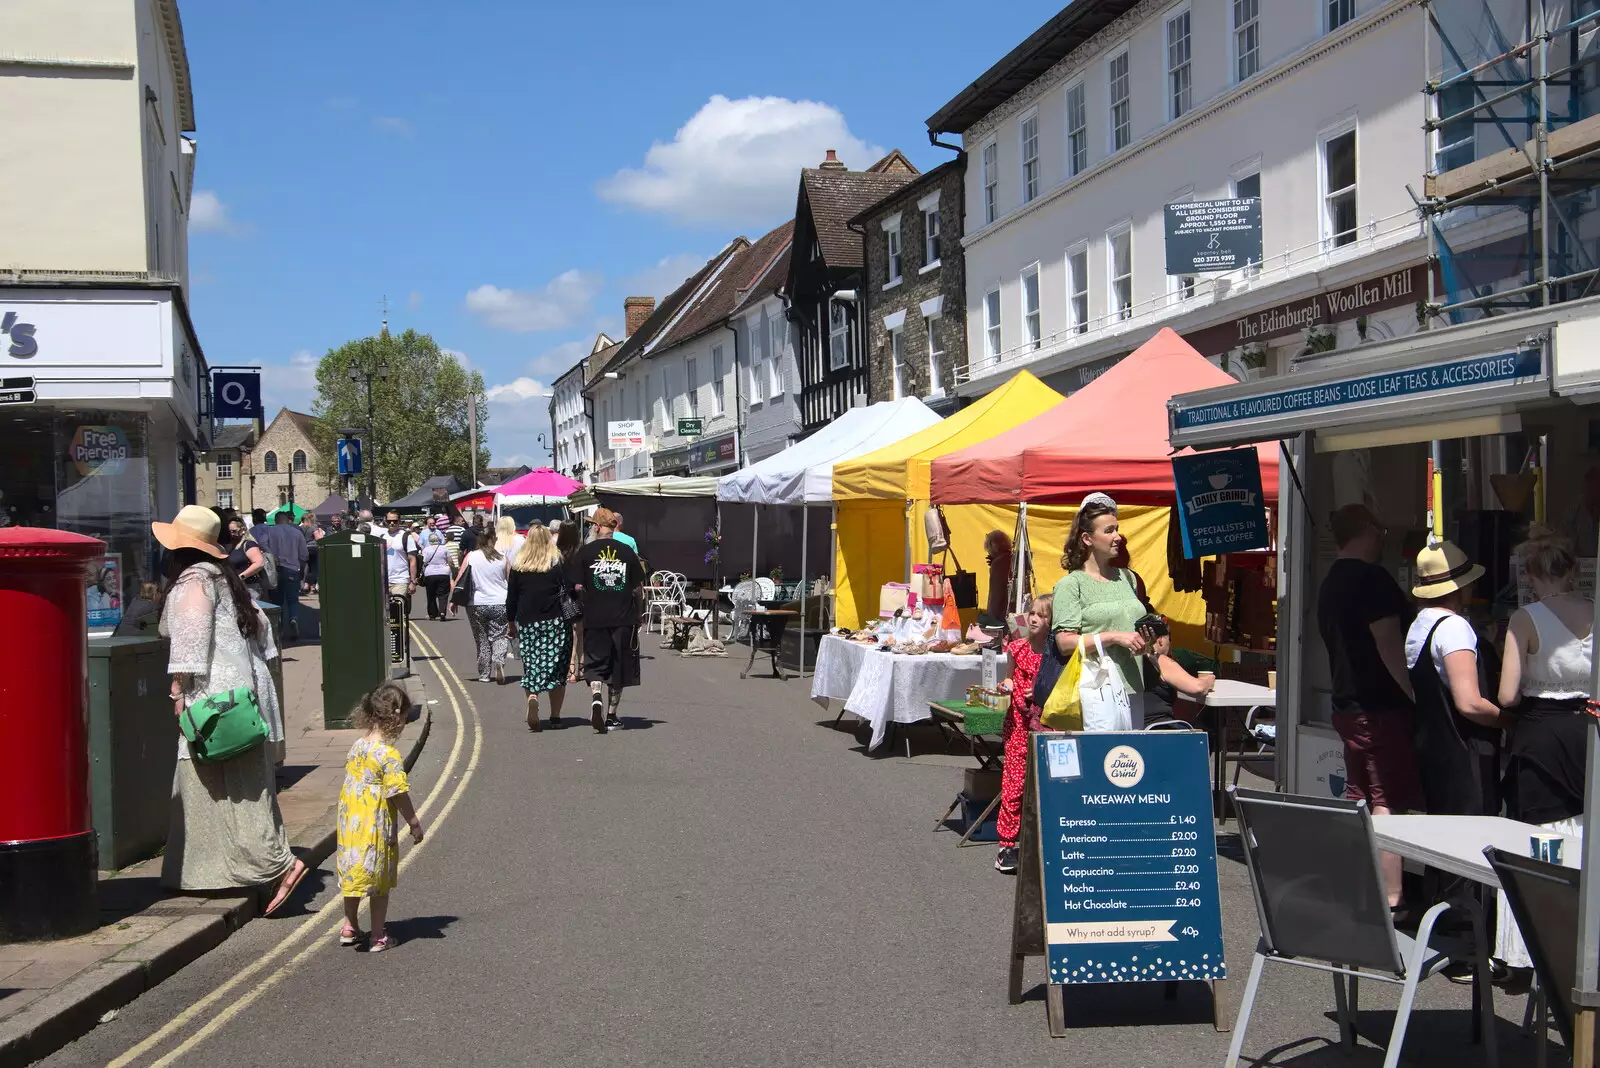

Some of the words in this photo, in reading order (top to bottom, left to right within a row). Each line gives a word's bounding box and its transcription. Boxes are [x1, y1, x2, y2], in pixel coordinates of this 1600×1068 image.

[1170, 201, 1213, 210] COMMERCIAL
[1208, 205, 1250, 213] CONSIDERED
[1186, 214, 1214, 222] GROUND
[1180, 221, 1208, 229] APPROX.
[1236, 319, 1258, 340] The
[1260, 297, 1321, 334] Edinburgh
[1326, 284, 1380, 315] Woollen
[1383, 269, 1412, 300] Mill
[1187, 405, 1232, 423] TRADITIONAL
[1233, 406, 1239, 417] &
[1240, 397, 1281, 416] FLAVOURED
[1283, 391, 1311, 409] COFFEE
[1314, 386, 1341, 404] BEANS
[1347, 380, 1376, 399] LOOSE
[1379, 376, 1401, 394] LEAF
[1403, 371, 1428, 391] TEAS
[1431, 369, 1440, 386] &
[1441, 357, 1515, 384] ACCESSORIES
[83, 430, 117, 446] Free
[76, 446, 126, 460] Piercing
[1194, 492, 1218, 507] DAILY
[1219, 490, 1247, 502] GRIND
[1192, 521, 1245, 537] SPECIALISTS
[1246, 520, 1256, 529] IN
[1197, 538, 1214, 547] TEA
[1216, 536, 1222, 544] &
[1224, 531, 1255, 543] COFFEE
[1049, 742, 1075, 754] TEA
[1110, 759, 1138, 771] Daily
[1111, 768, 1138, 778] Grind
[1081, 794, 1137, 805] TAKEAWAY
[1138, 793, 1171, 804] MENU
[1059, 816, 1097, 828] Espresso
[1060, 833, 1108, 843] Americano
[1171, 831, 1198, 841] £2.00
[1061, 850, 1085, 860] Latte
[1171, 847, 1197, 857] £2.20
[1062, 866, 1115, 879] Cappuccino
[1174, 864, 1199, 874] £2.20
[1063, 882, 1095, 893] Mocha
[1175, 881, 1200, 890] £2.40
[1064, 900, 1081, 910] Hot
[1083, 898, 1128, 909] Chocolate
[1175, 897, 1201, 907] £2.40
[1066, 928, 1088, 939] Why
[1090, 928, 1105, 937] not
[1107, 926, 1125, 937] add
[1127, 926, 1156, 938] syrup?
[1181, 926, 1199, 938] 40p
